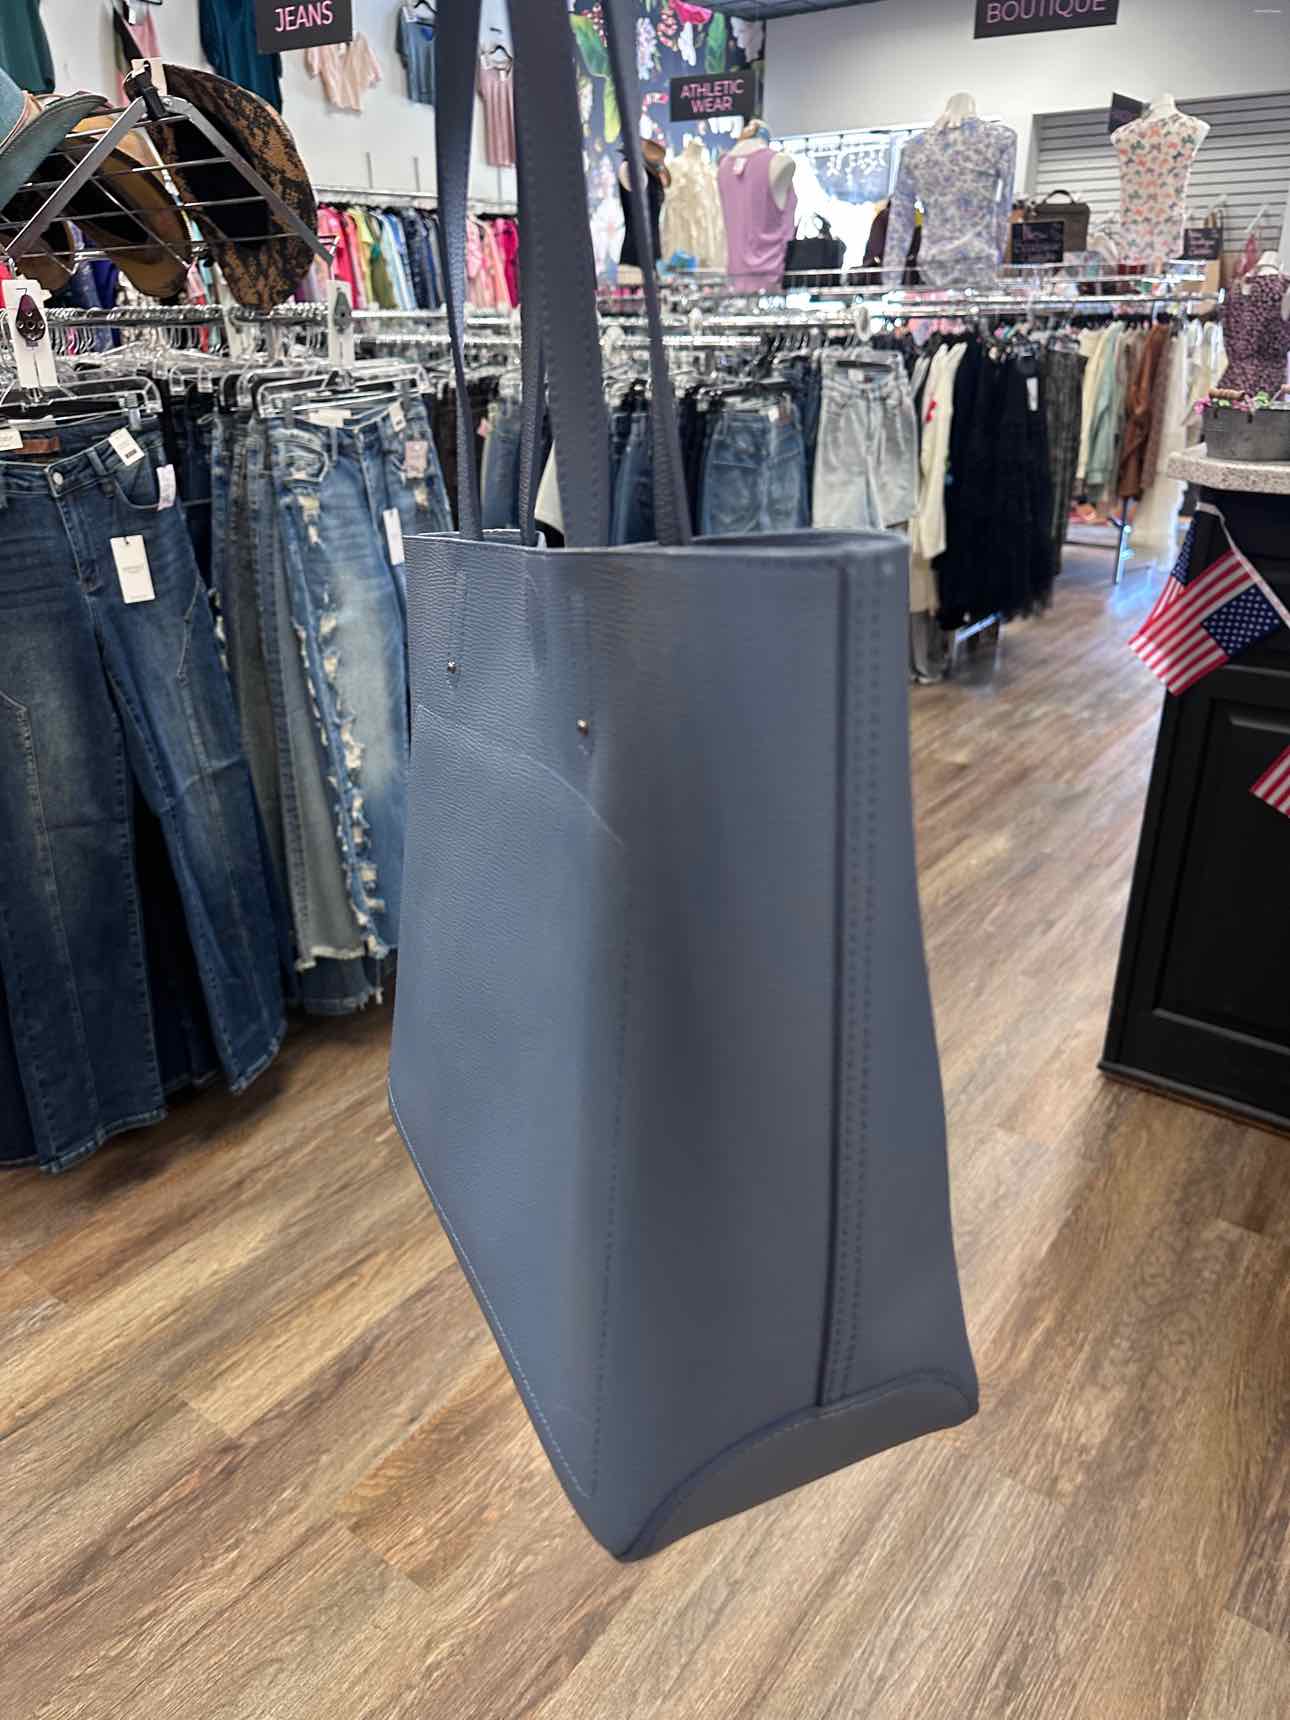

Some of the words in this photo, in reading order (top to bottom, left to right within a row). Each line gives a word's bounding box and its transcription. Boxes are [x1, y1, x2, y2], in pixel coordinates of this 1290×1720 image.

[274, 0, 333, 32] JEANS
[986, 0, 1106, 23] BOUTIQUE
[680, 79, 744, 98] ATHLETIC
[690, 96, 733, 113] WEAR
